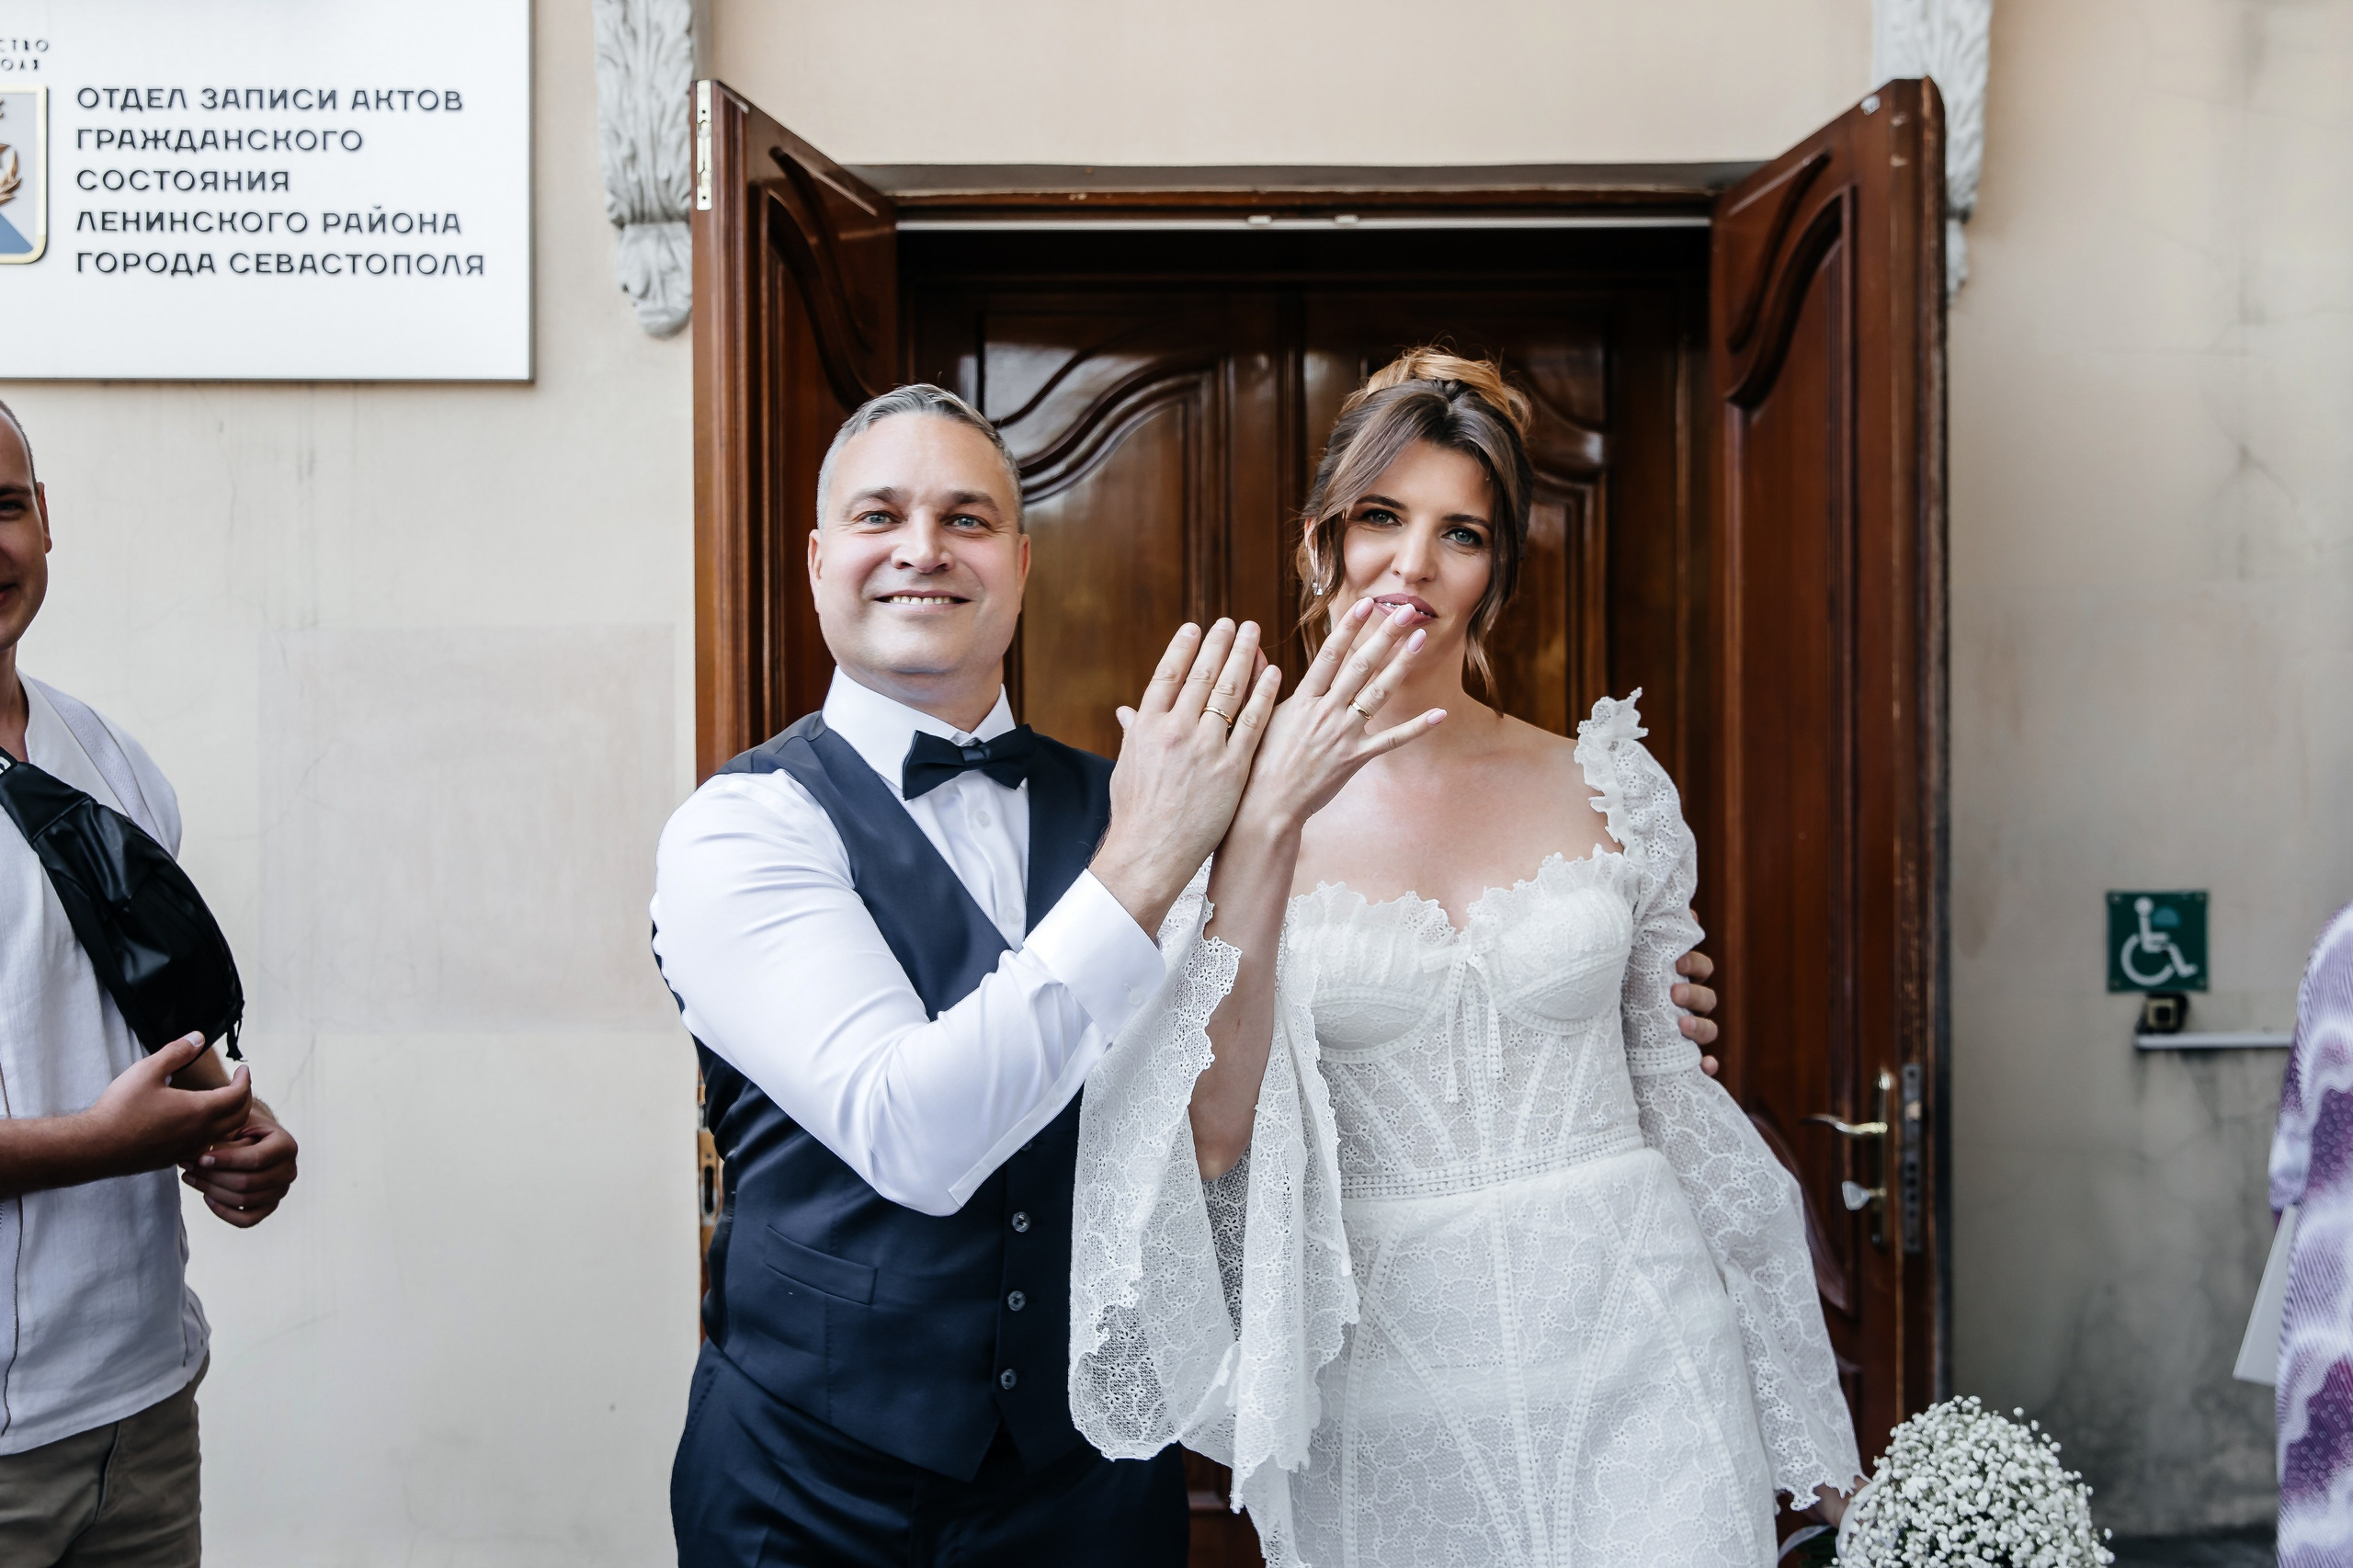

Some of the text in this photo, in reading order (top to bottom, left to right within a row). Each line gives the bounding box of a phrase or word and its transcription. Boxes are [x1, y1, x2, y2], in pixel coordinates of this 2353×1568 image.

[77, 87, 462, 112] ОТДЕЛ ЗАПИСИ АКТОВ
[77, 129, 363, 153] ГРАЖДАНСКОГО
[76, 169, 289, 191] СОСТОЯНИЯ
[76, 205, 460, 234] ЛЕНИНСКОГО РАЙОНА
[77, 252, 484, 277] ГОРОДА СЕВАСТОПОЛЯ
